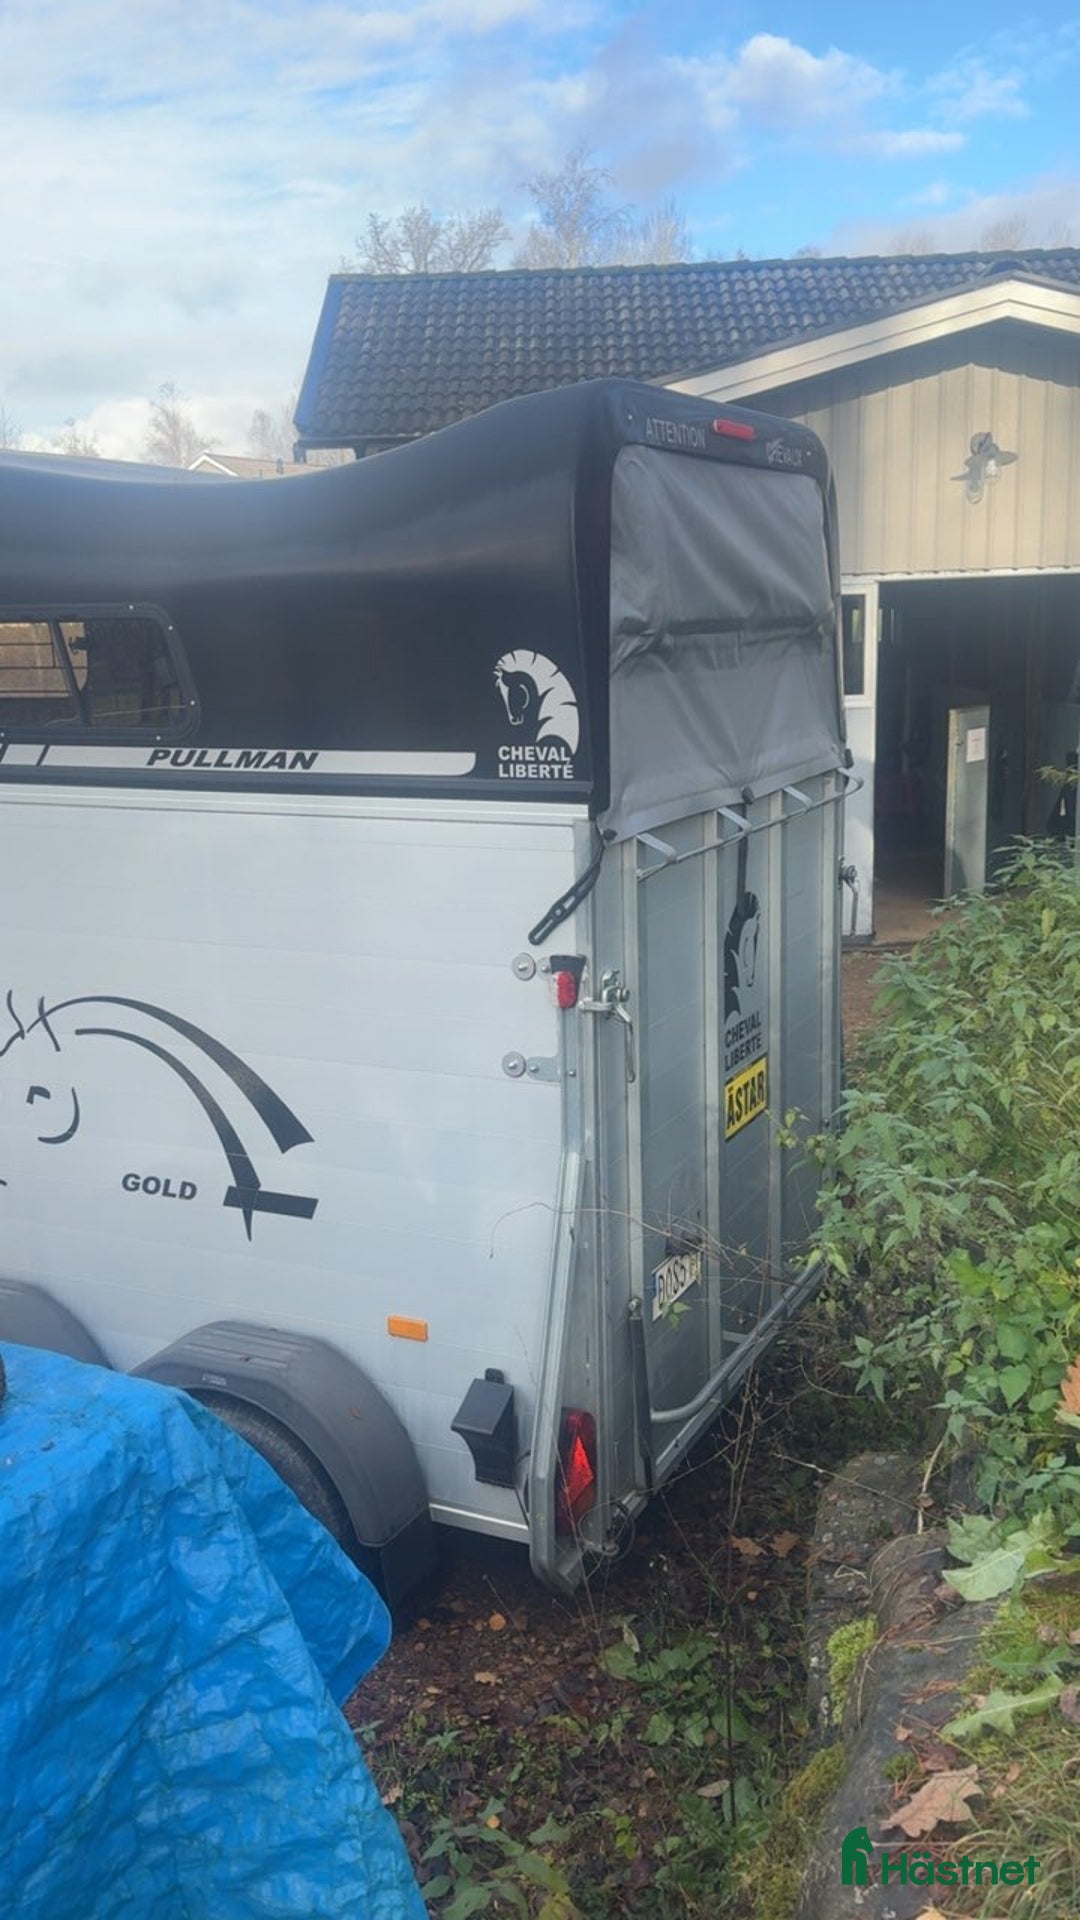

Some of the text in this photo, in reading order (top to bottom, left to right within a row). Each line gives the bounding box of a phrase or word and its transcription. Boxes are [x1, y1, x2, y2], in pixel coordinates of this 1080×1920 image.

[646, 417, 706, 448] ATTENTION
[146, 749, 319, 771] PULLMAN
[498, 745, 571, 761] CHEVAL
[724, 1010, 762, 1048] CHEVAL
[121, 1173, 198, 1201] GOLD
